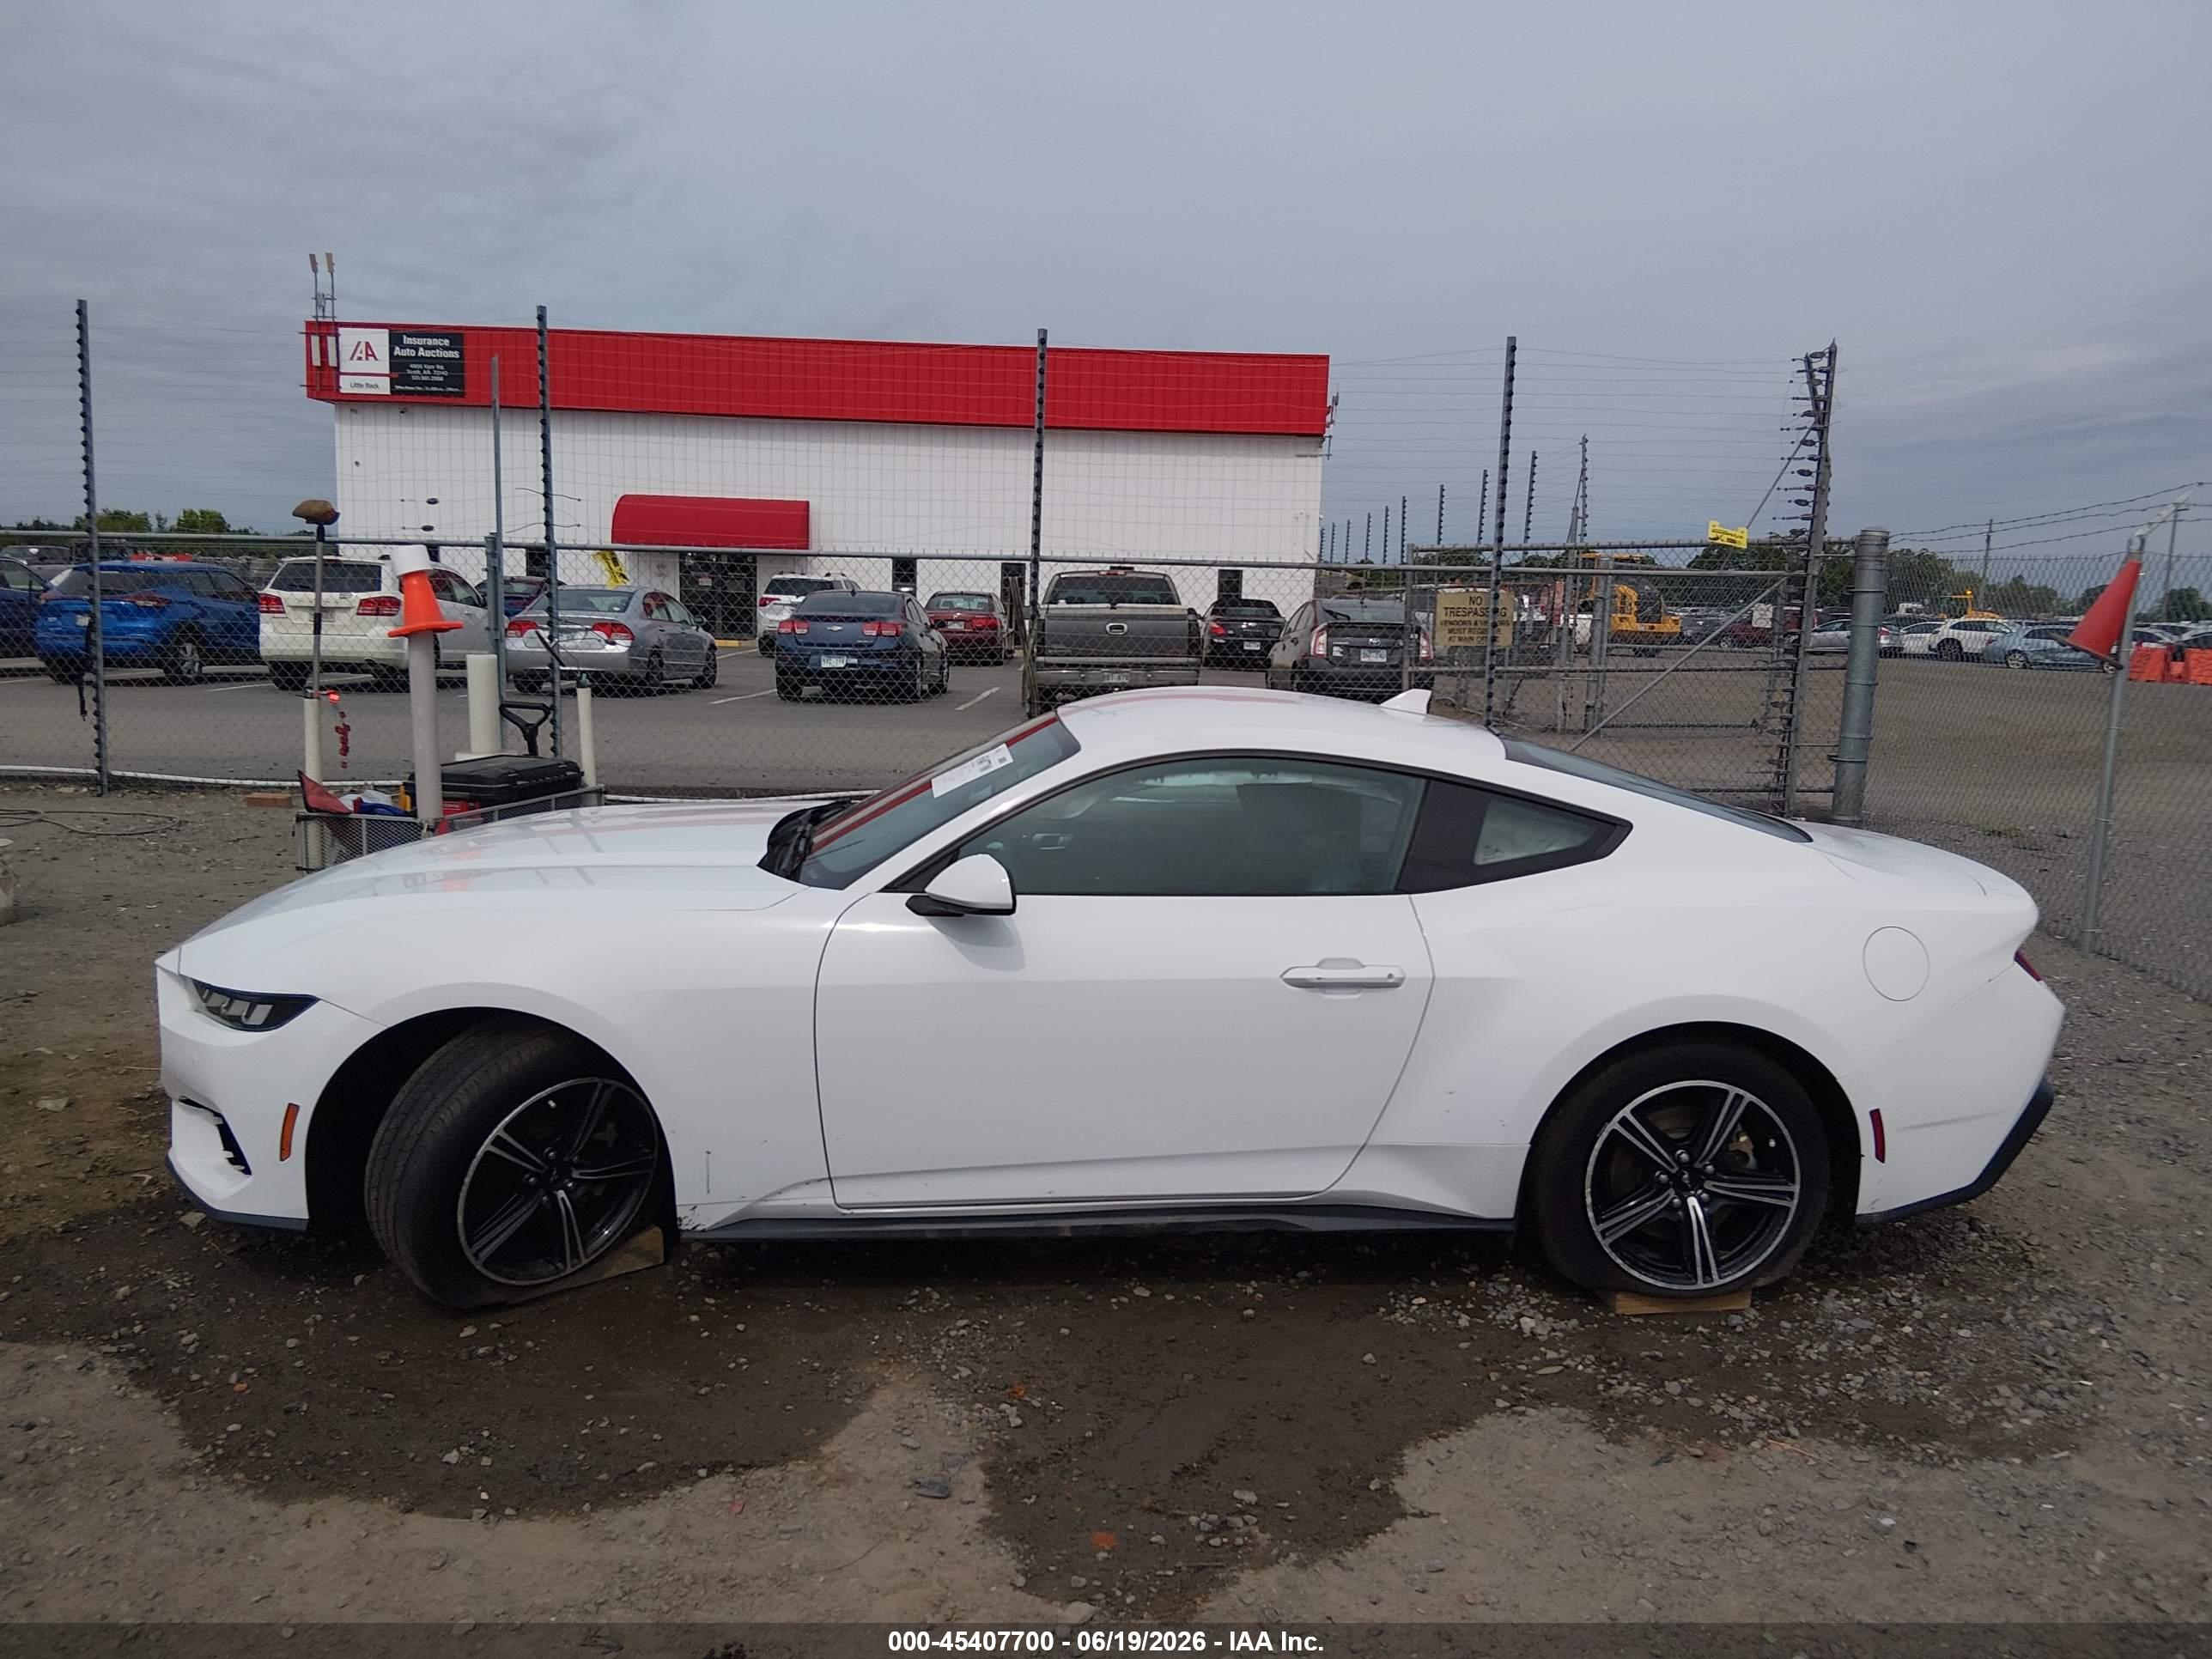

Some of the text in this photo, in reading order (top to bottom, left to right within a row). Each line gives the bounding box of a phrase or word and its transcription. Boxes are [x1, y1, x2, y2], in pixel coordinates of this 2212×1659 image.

[402, 334, 450, 346] Insurance
[393, 346, 460, 359] Auto Auctions
[1468, 596, 1483, 606] NO
[1443, 606, 1508, 617] TRESPASSG
